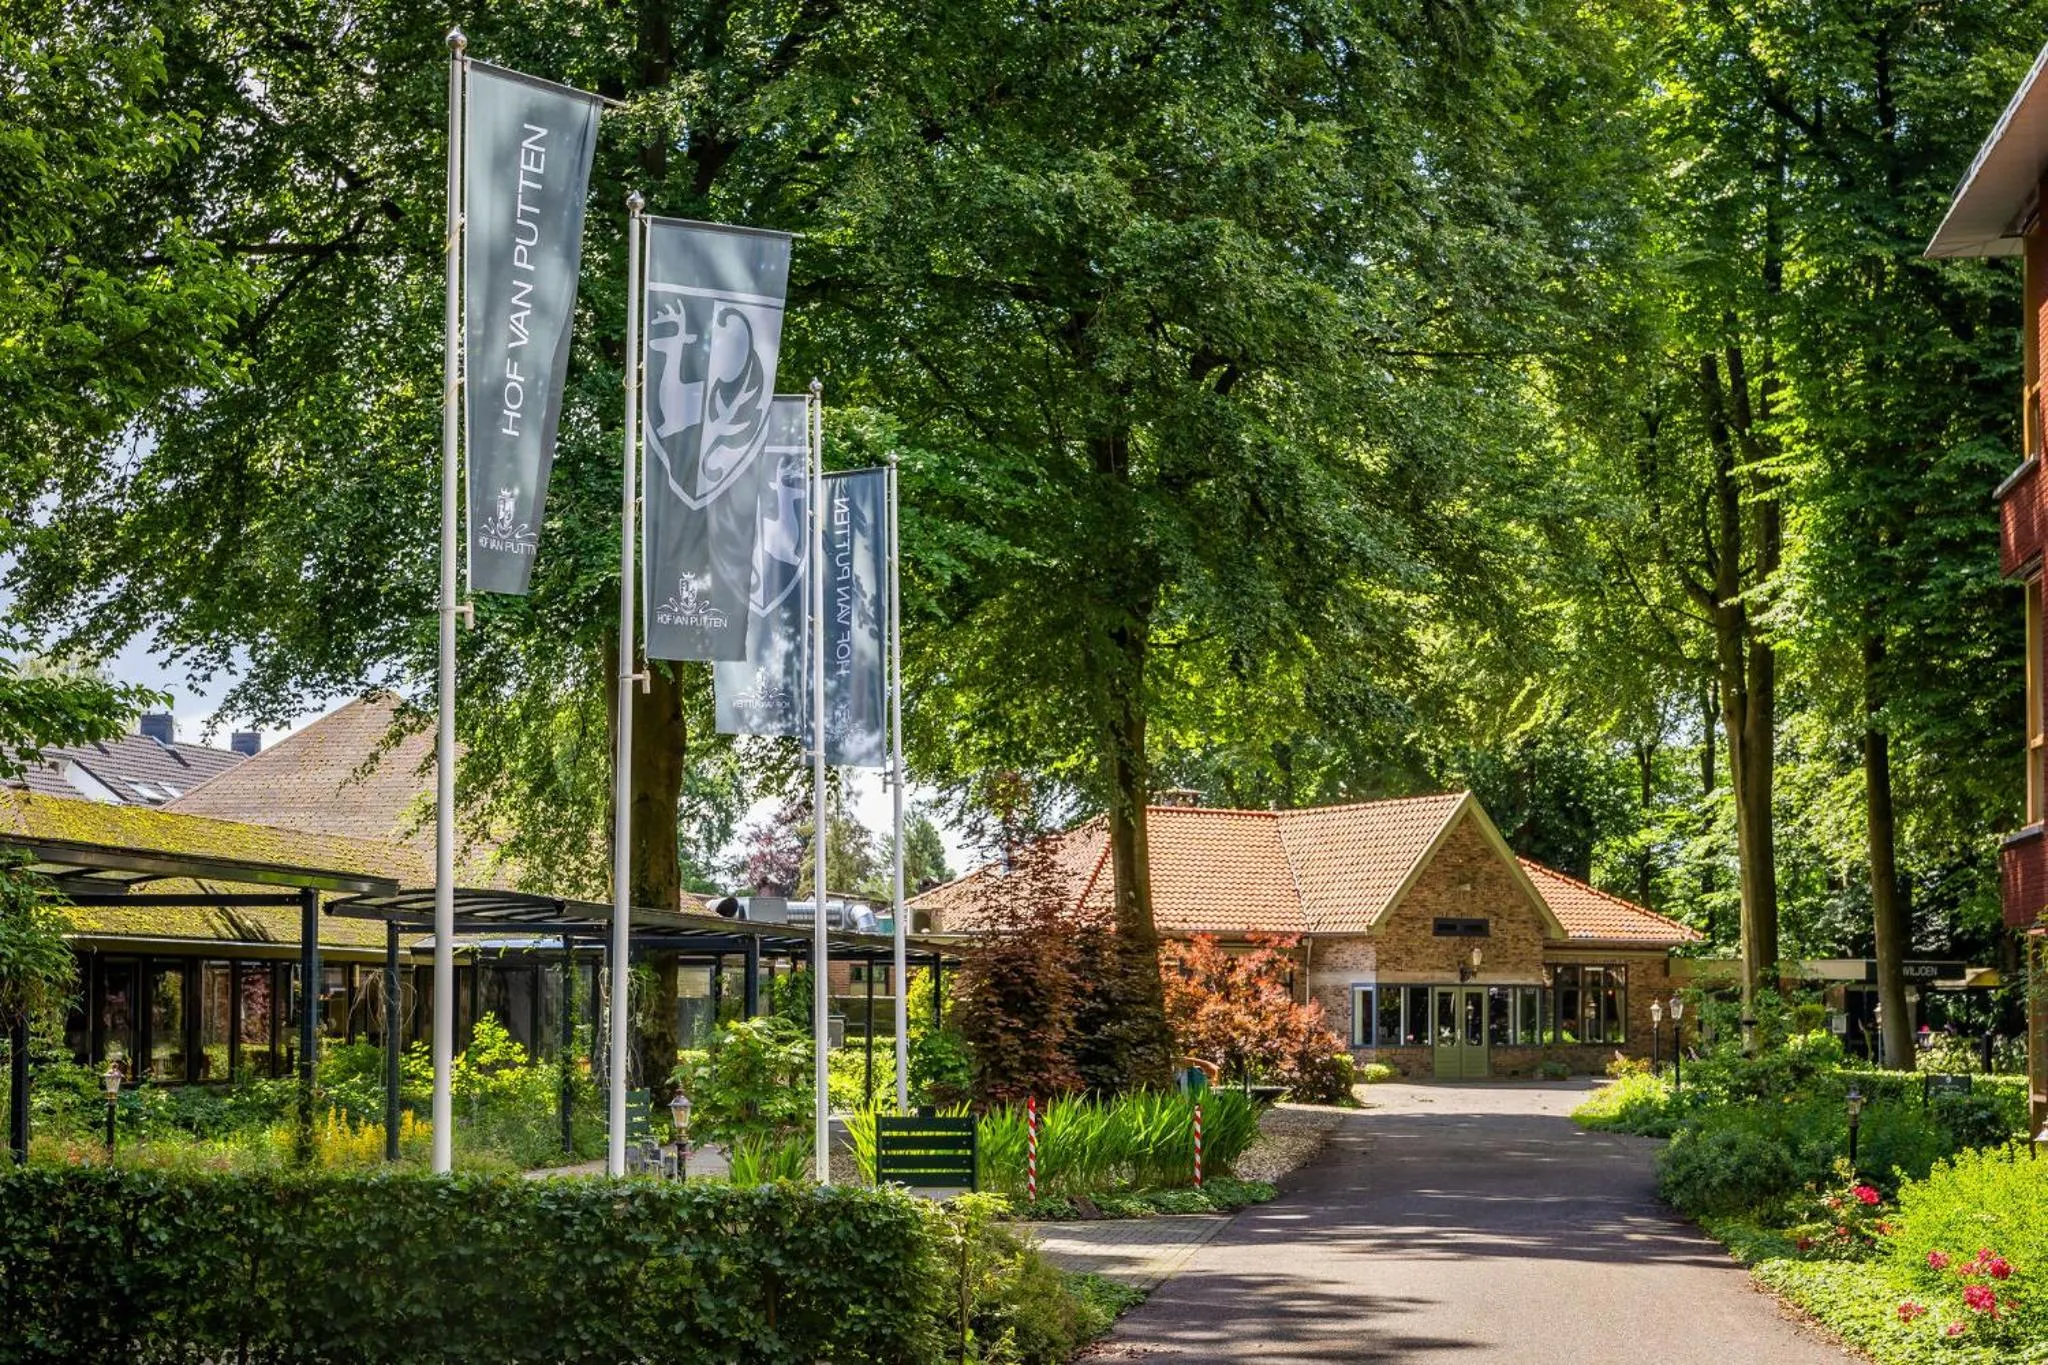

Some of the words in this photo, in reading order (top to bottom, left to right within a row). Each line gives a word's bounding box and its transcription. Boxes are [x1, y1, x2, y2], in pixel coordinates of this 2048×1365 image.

[513, 123, 548, 271] PUTTEN
[508, 280, 533, 348] VAN
[502, 358, 525, 437] HOF
